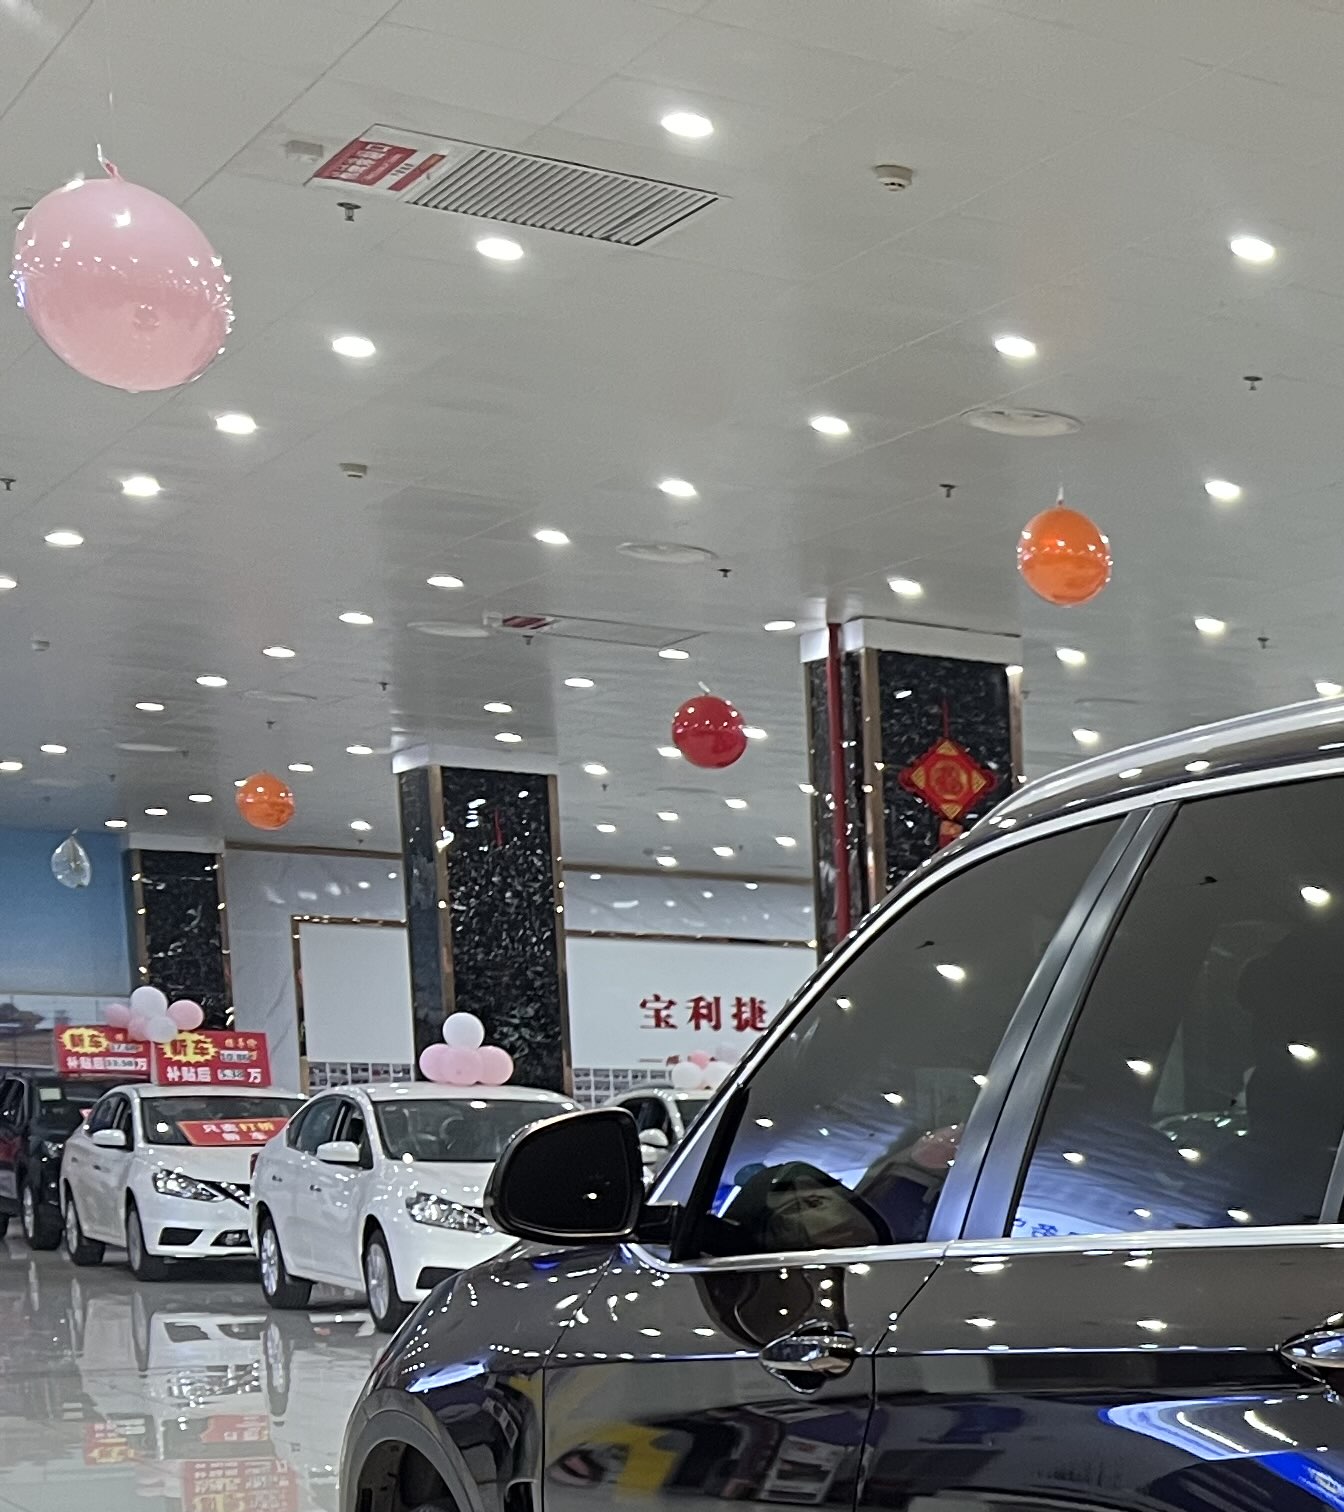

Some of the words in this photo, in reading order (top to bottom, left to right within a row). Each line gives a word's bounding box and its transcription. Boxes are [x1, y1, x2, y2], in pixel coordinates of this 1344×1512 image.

[640, 994, 769, 1032] 宝利捷
[248, 1068, 263, 1083] 万
